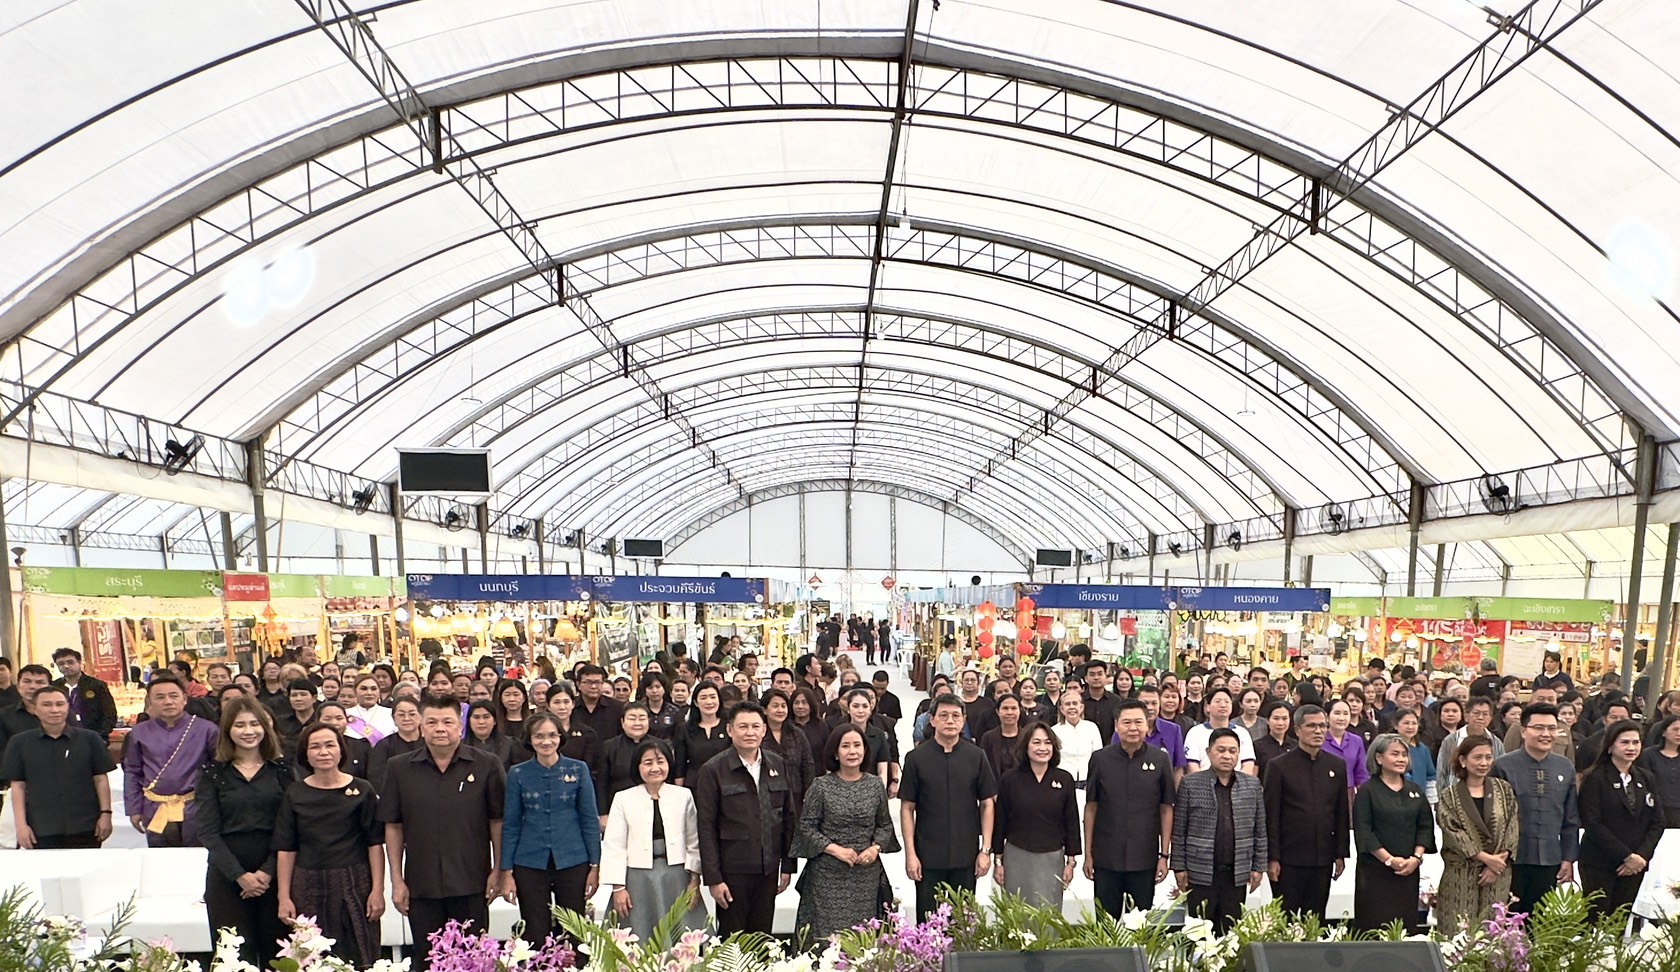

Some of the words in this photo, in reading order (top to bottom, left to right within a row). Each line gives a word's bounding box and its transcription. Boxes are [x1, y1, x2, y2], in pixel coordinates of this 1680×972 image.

[105, 575, 144, 591] สระบุรี
[408, 574, 433, 582] OTOP
[479, 580, 519, 595] นนทบุรี
[1078, 590, 1119, 602] เชียงราย
[1233, 594, 1279, 604] หนองคาย
[1523, 603, 1566, 615] ฉะเชิงเทรา
